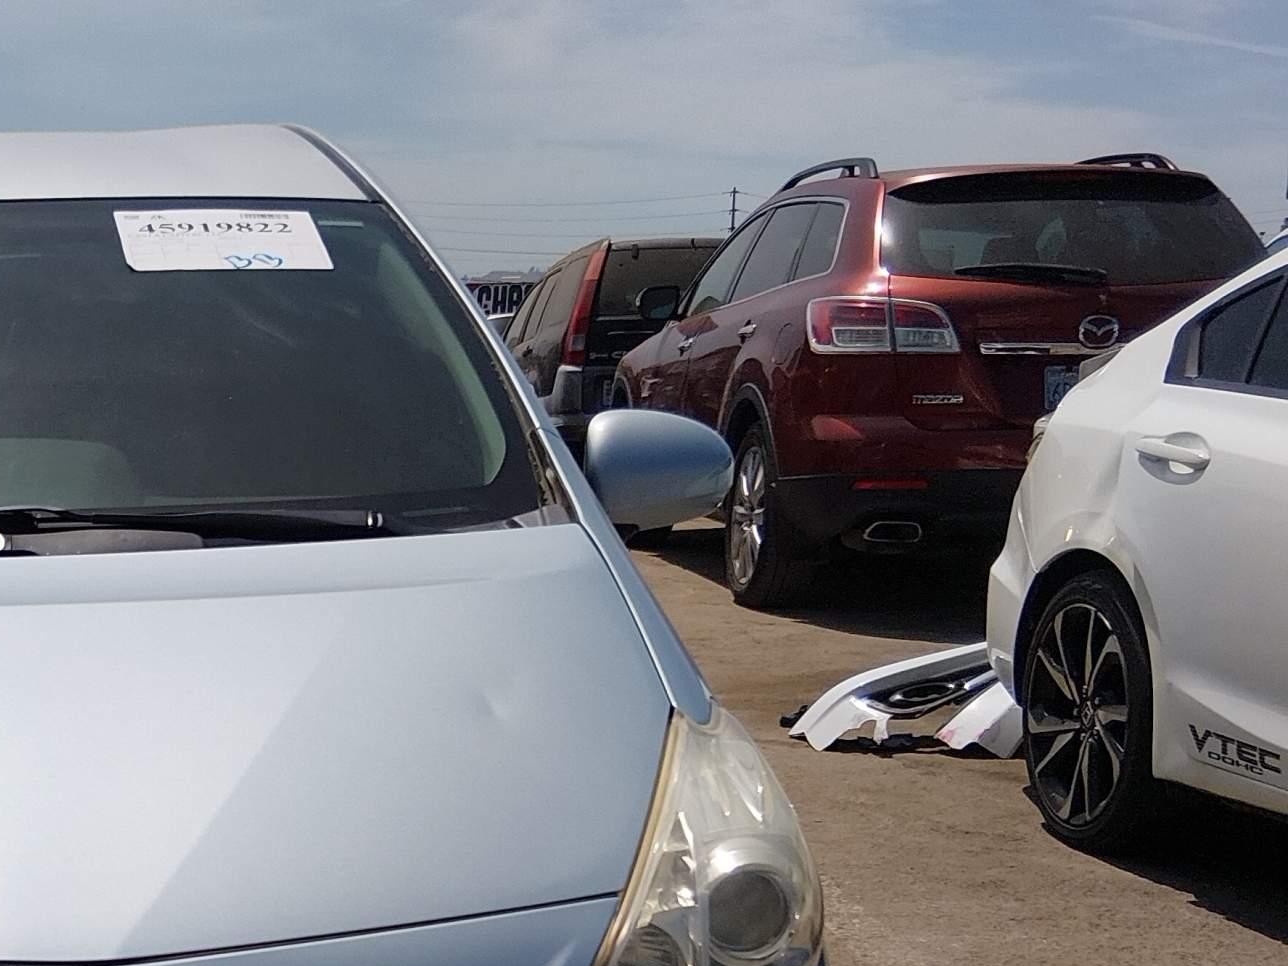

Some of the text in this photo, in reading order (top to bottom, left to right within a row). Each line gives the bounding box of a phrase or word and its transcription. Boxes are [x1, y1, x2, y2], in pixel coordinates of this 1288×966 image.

[138, 222, 293, 234] 45919822
[1188, 723, 1282, 774] VTEC
[1207, 751, 1263, 776] DOHC
